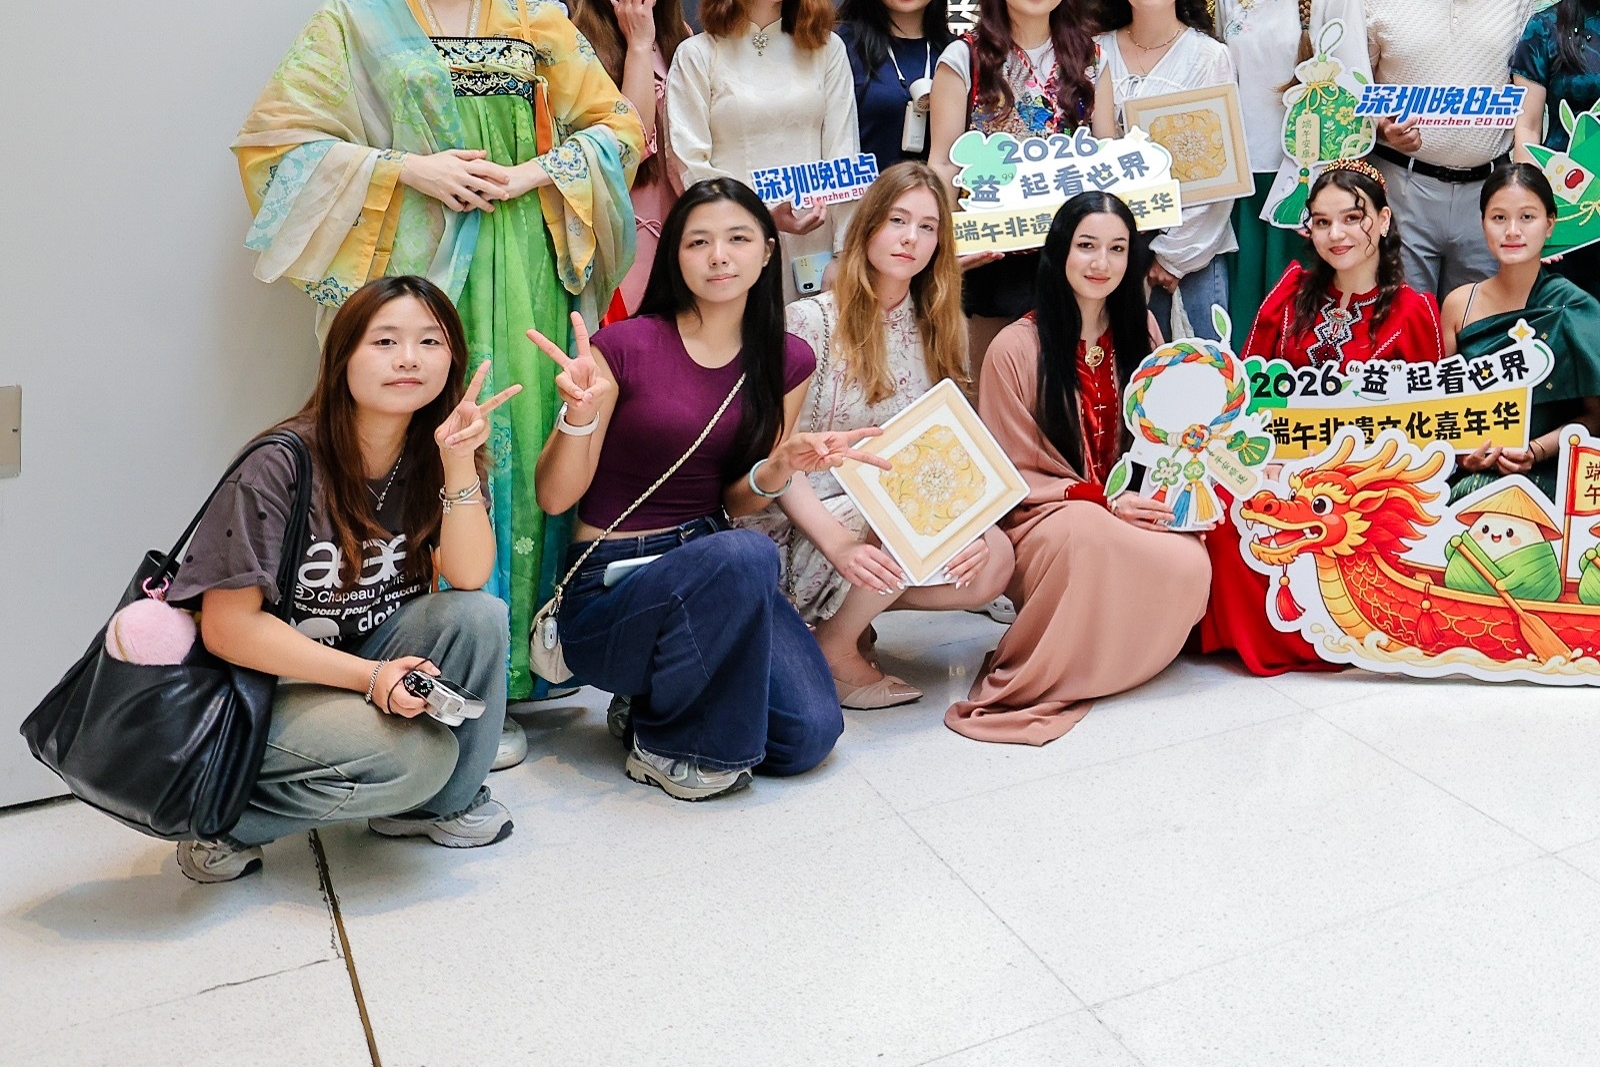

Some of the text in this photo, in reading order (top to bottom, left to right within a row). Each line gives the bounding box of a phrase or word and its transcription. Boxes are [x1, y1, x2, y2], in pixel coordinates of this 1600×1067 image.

[1416, 117, 1514, 126] henzhen 20:00
[997, 129, 1099, 165] 2026
[954, 191, 1175, 243] 端午非遗年华
[1251, 364, 1343, 398] 2026
[317, 587, 376, 605] Chapeau
[384, 584, 421, 602] vacan
